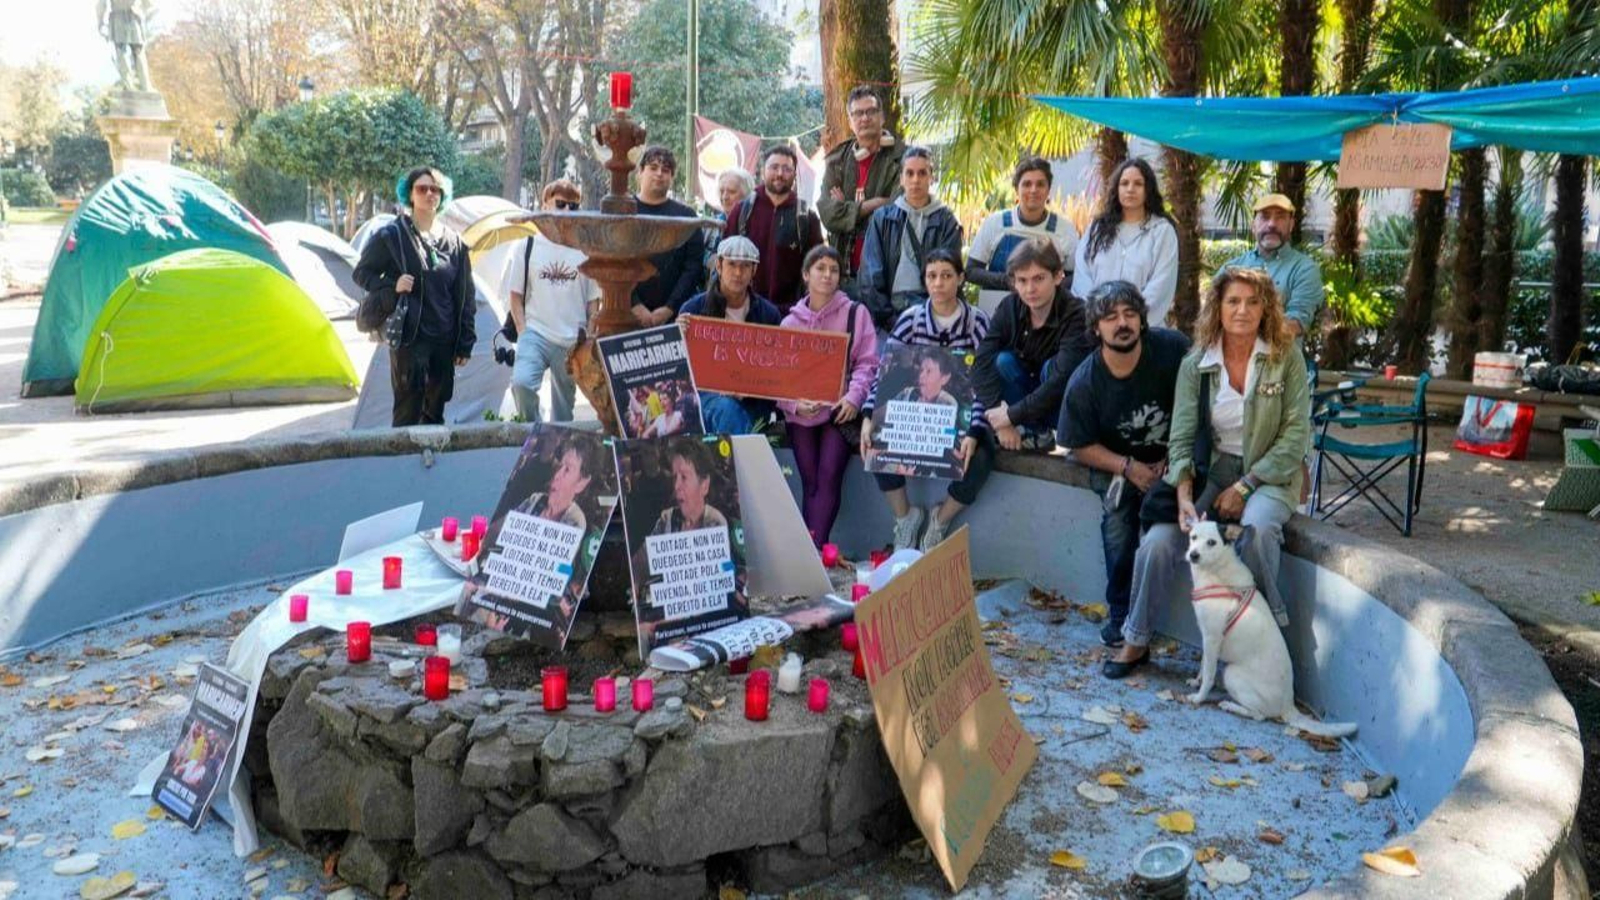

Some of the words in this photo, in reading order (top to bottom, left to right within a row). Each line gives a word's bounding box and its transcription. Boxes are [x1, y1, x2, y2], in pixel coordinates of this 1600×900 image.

[609, 340, 686, 375] MARICARMEN
[888, 413, 920, 423] QUEDEDES
[923, 416, 931, 424] NA
[924, 406, 938, 415] NON
[939, 407, 953, 417] VOS
[895, 424, 922, 433] LOITADE
[924, 427, 942, 435] POLA
[890, 442, 918, 451] DEREITO
[919, 443, 925, 451] A
[930, 435, 952, 445] TEMOS
[500, 531, 537, 550] QUEDEDES
[537, 540, 548, 553] NA
[542, 526, 559, 540] NON
[560, 531, 577, 546] VOS
[693, 535, 708, 546] NON
[710, 532, 725, 544] VOS
[504, 548, 534, 566] LOITADE
[534, 557, 555, 571] POLA
[651, 554, 693, 571] QUEDEDES
[695, 551, 706, 561] NA
[520, 568, 534, 582] QUE
[535, 573, 564, 592] TEMOS
[665, 568, 698, 584] LOITADE
[700, 564, 720, 577] POLA
[489, 576, 521, 595] DEREITO
[521, 583, 528, 592] A
[693, 582, 707, 593] QUE
[709, 576, 734, 591] TEMOS
[666, 599, 701, 616] DEREITO
[701, 598, 707, 608] A
